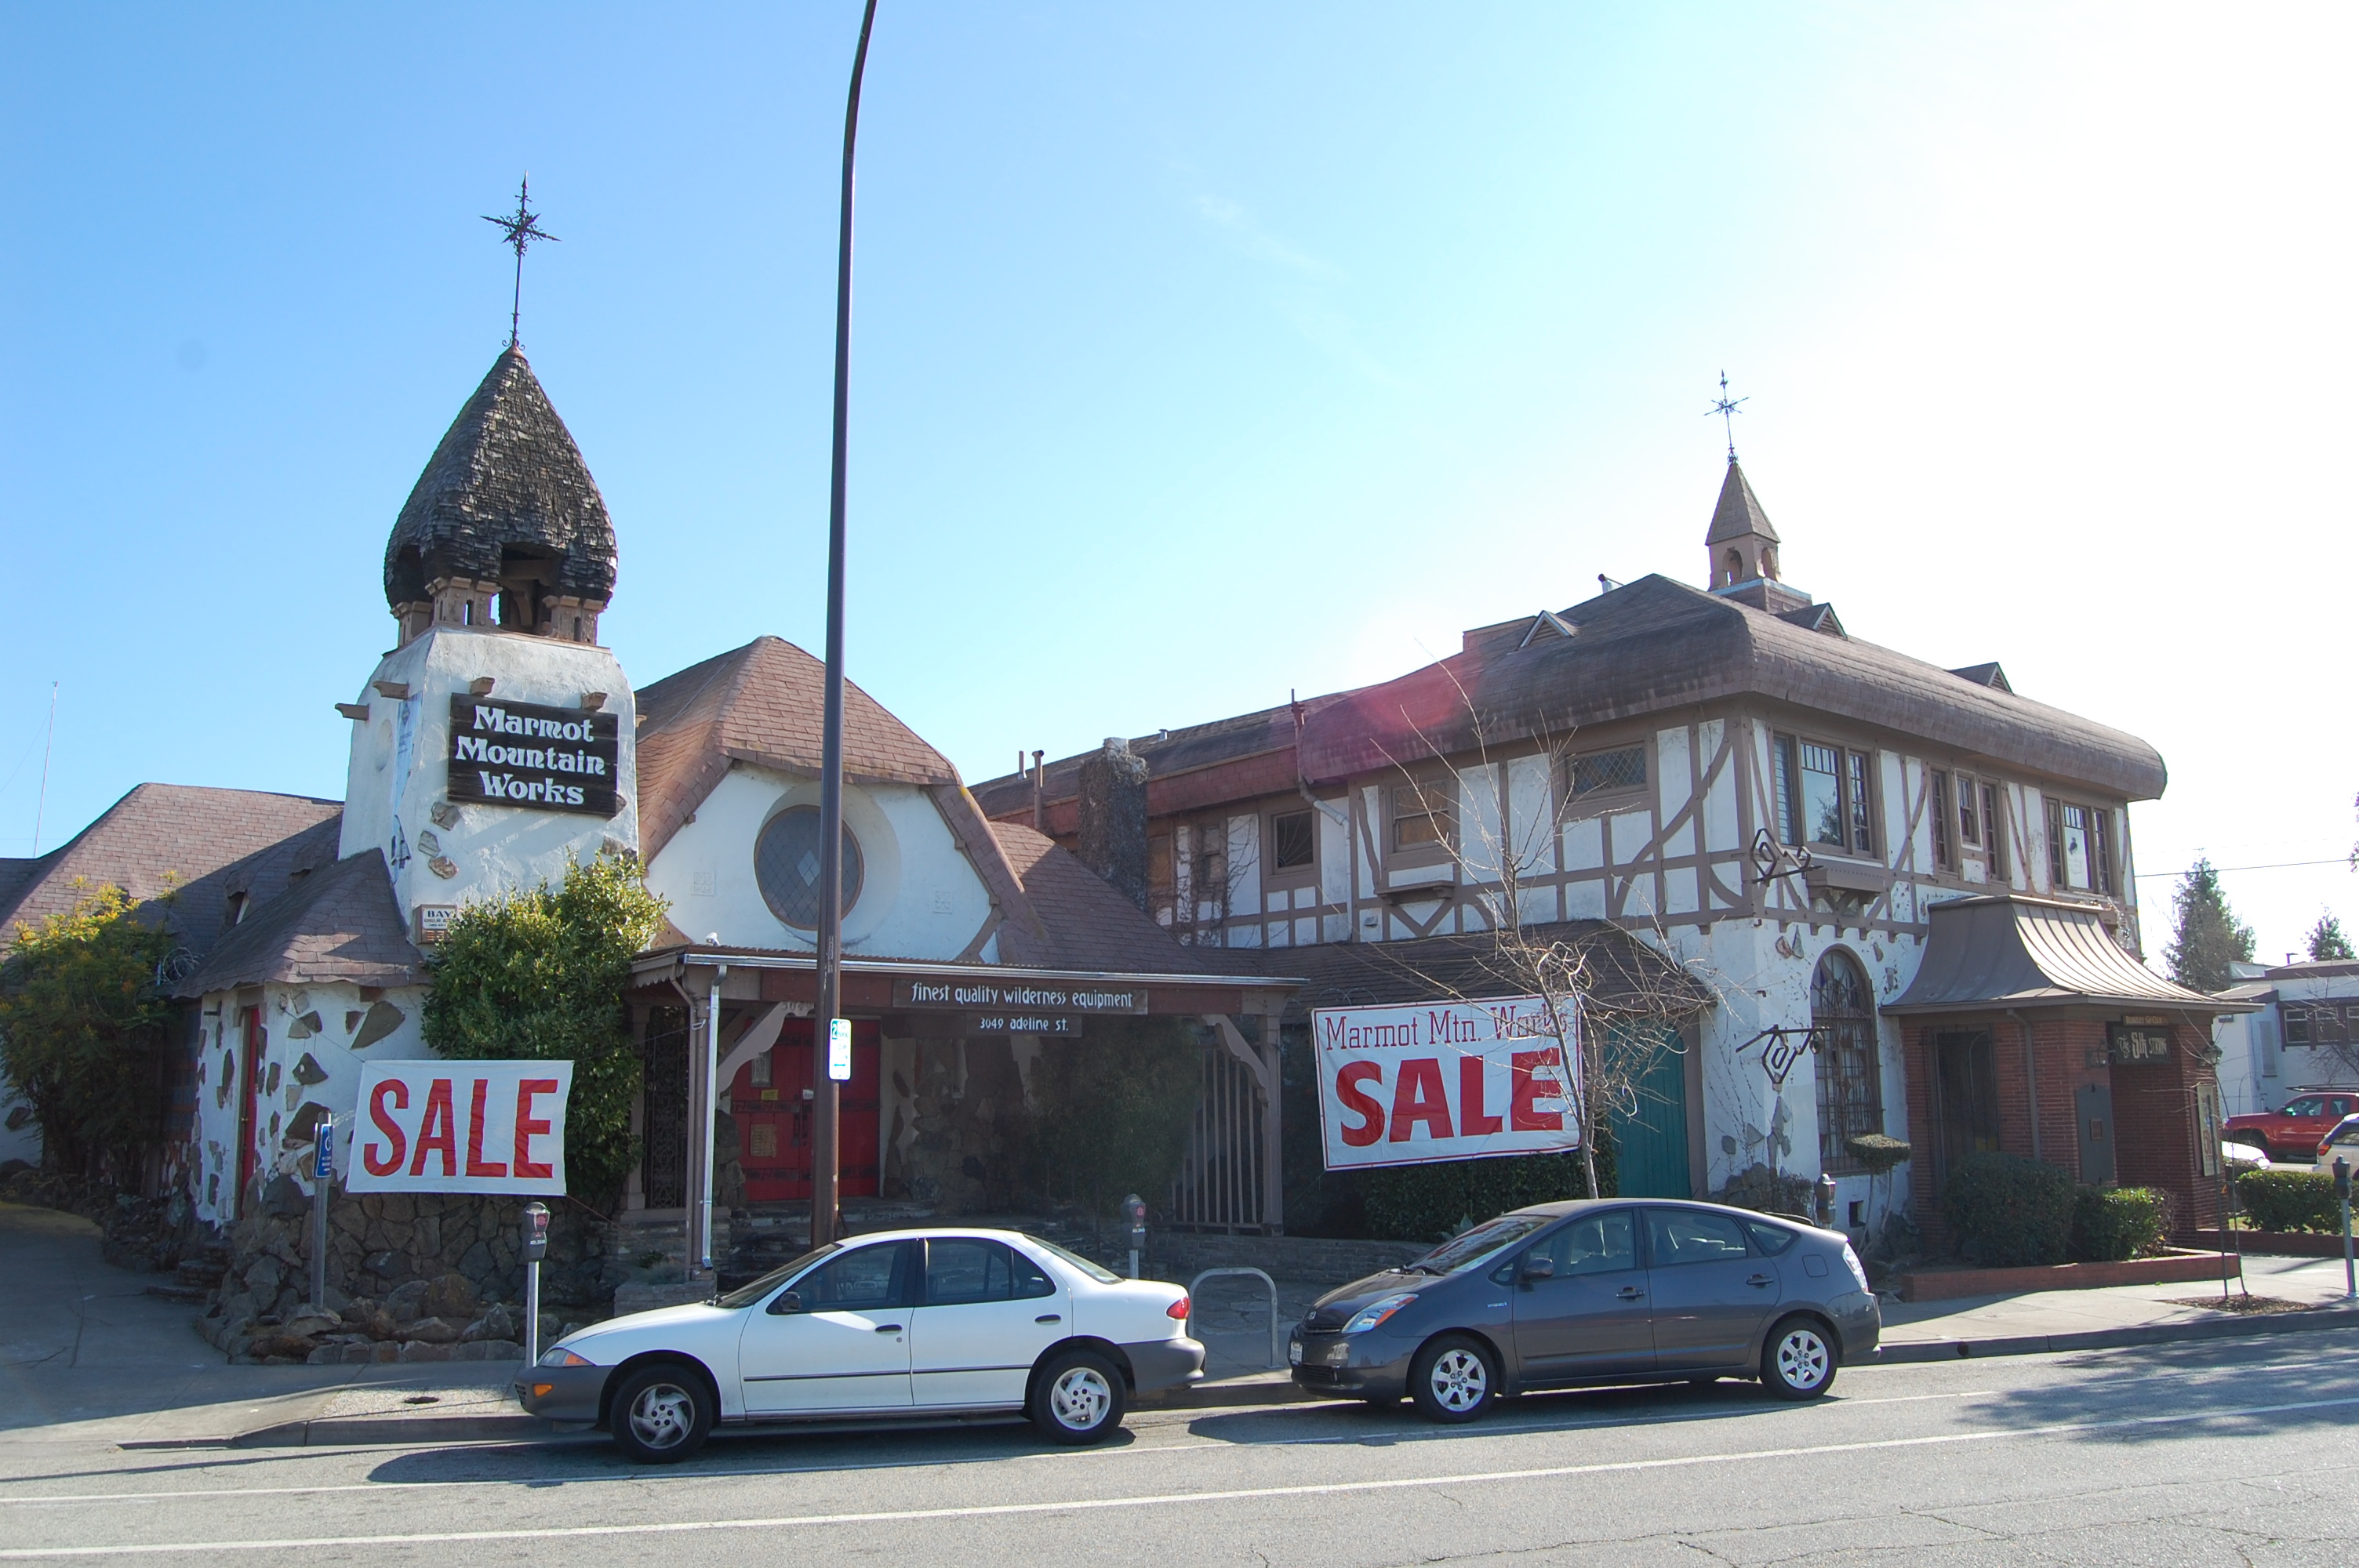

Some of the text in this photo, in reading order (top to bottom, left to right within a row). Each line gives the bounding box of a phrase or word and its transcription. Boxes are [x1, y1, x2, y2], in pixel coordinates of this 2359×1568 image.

[473, 704, 594, 742] Marmot
[456, 735, 605, 775] Mountain
[479, 771, 584, 805] Works
[911, 982, 1132, 1009] finest quality wilderness equipment
[980, 1017, 1069, 1032] 3049 adeline st.
[1325, 1016, 1419, 1051] Marmot
[1428, 1010, 1481, 1046] Mtn.
[1336, 1047, 1564, 1147] SALE
[363, 1079, 559, 1178] SALE
